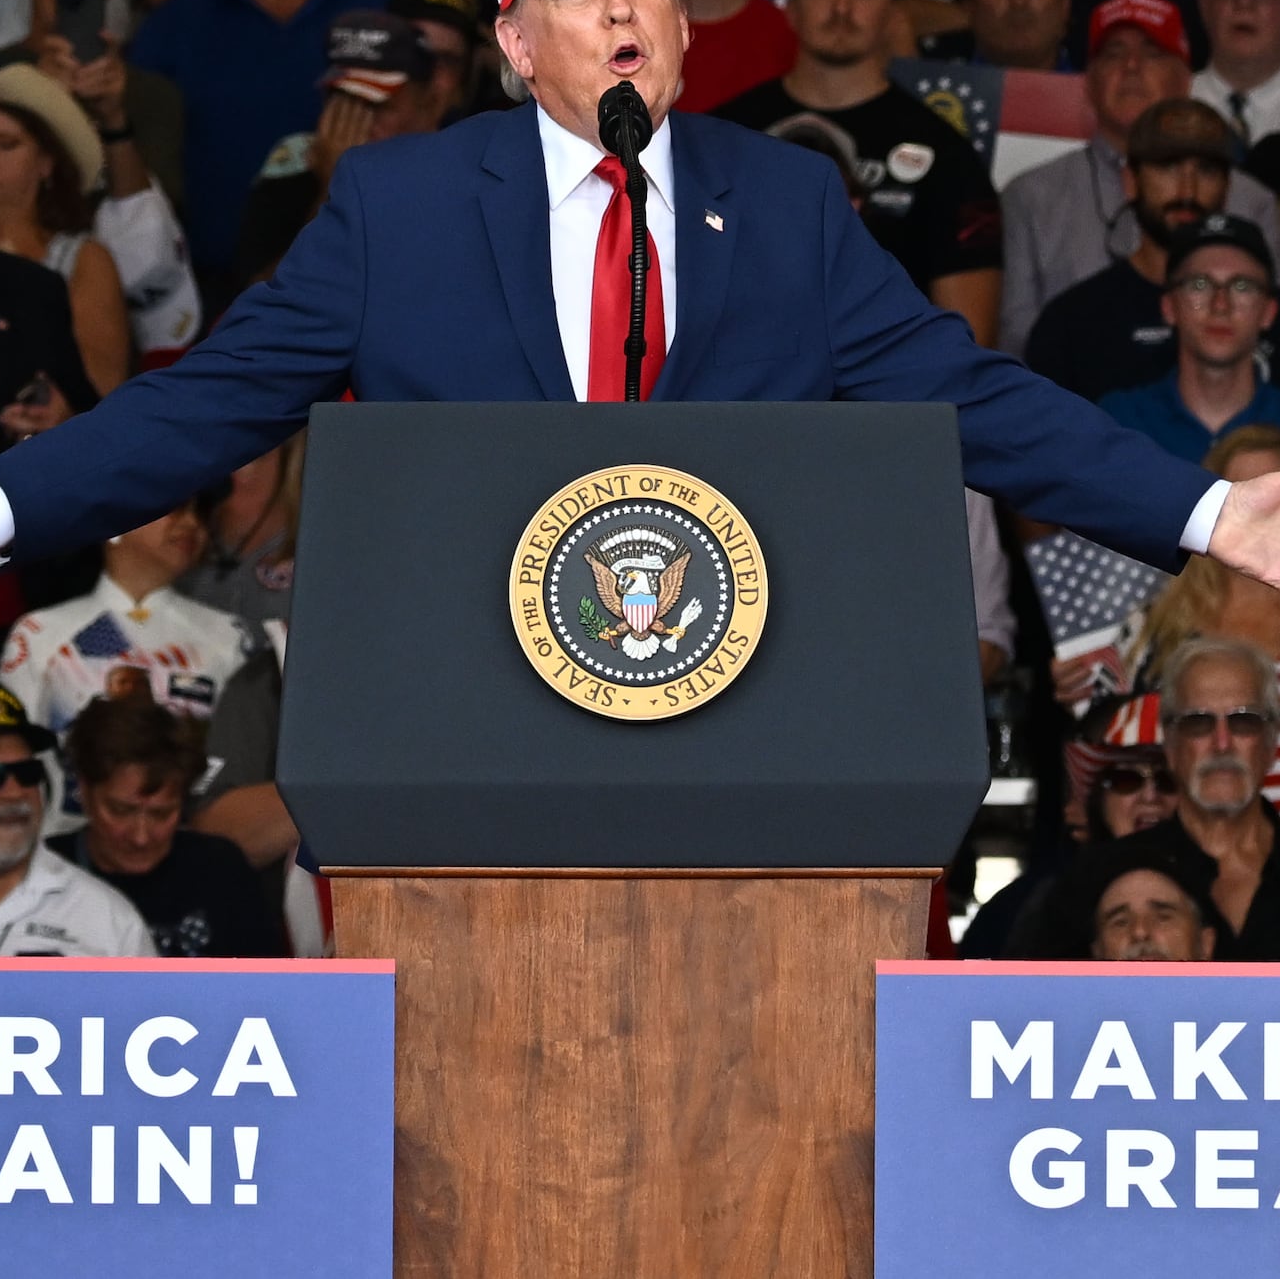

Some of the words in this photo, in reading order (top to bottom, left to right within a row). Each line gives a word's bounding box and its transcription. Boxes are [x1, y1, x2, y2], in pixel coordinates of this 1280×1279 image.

[638, 476, 663, 493] OF
[668, 480, 701, 507] THE
[519, 474, 632, 588] PRESIDENT
[704, 503, 760, 607] UNITED
[521, 595, 541, 632] THE
[533, 635, 553, 658] OF
[662, 628, 750, 708] STATES
[552, 655, 618, 708] SEAL
